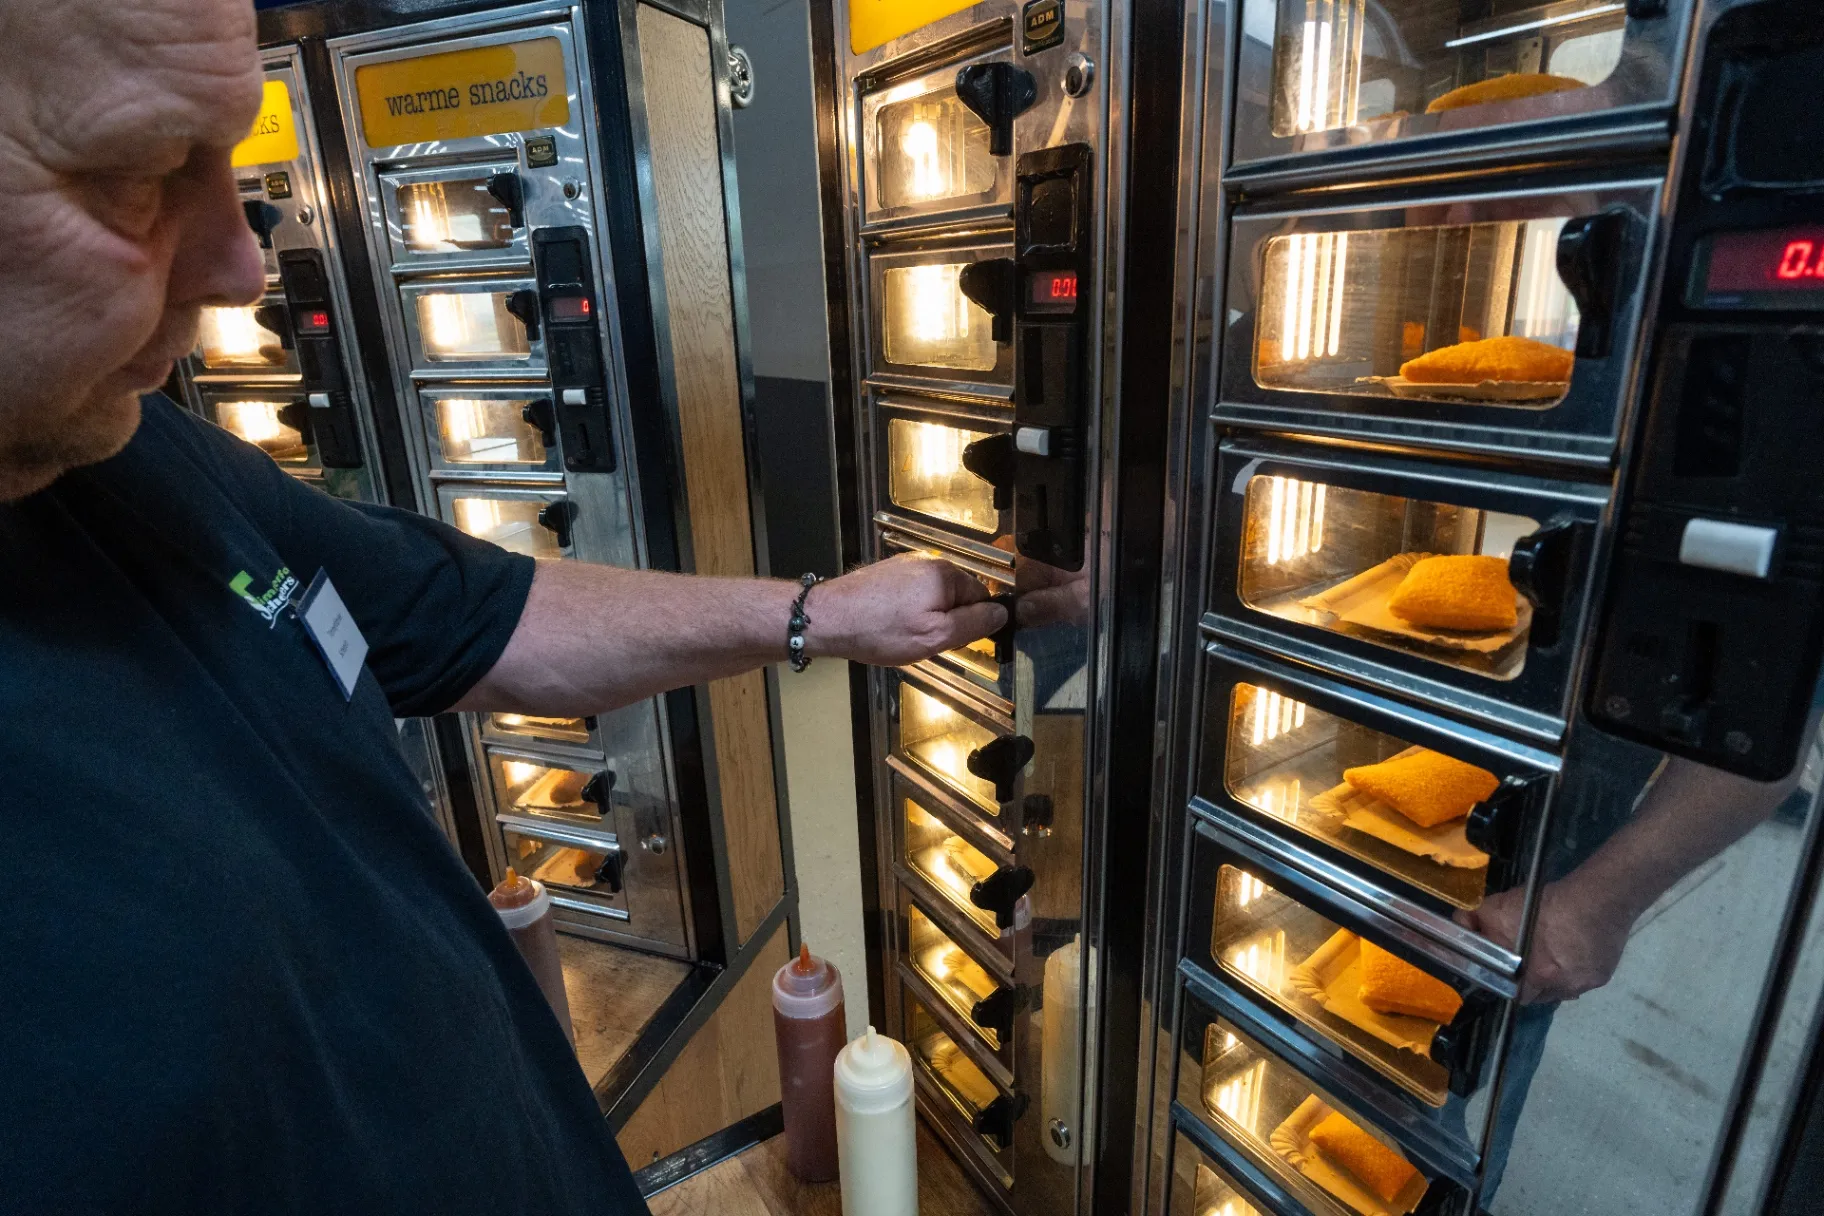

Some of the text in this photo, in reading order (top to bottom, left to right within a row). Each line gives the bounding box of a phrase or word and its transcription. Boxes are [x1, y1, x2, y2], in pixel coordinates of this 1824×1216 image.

[1031, 9, 1055, 27] ADM
[385, 71, 548, 117] warme snacks
[1777, 240, 1824, 278] 0.
